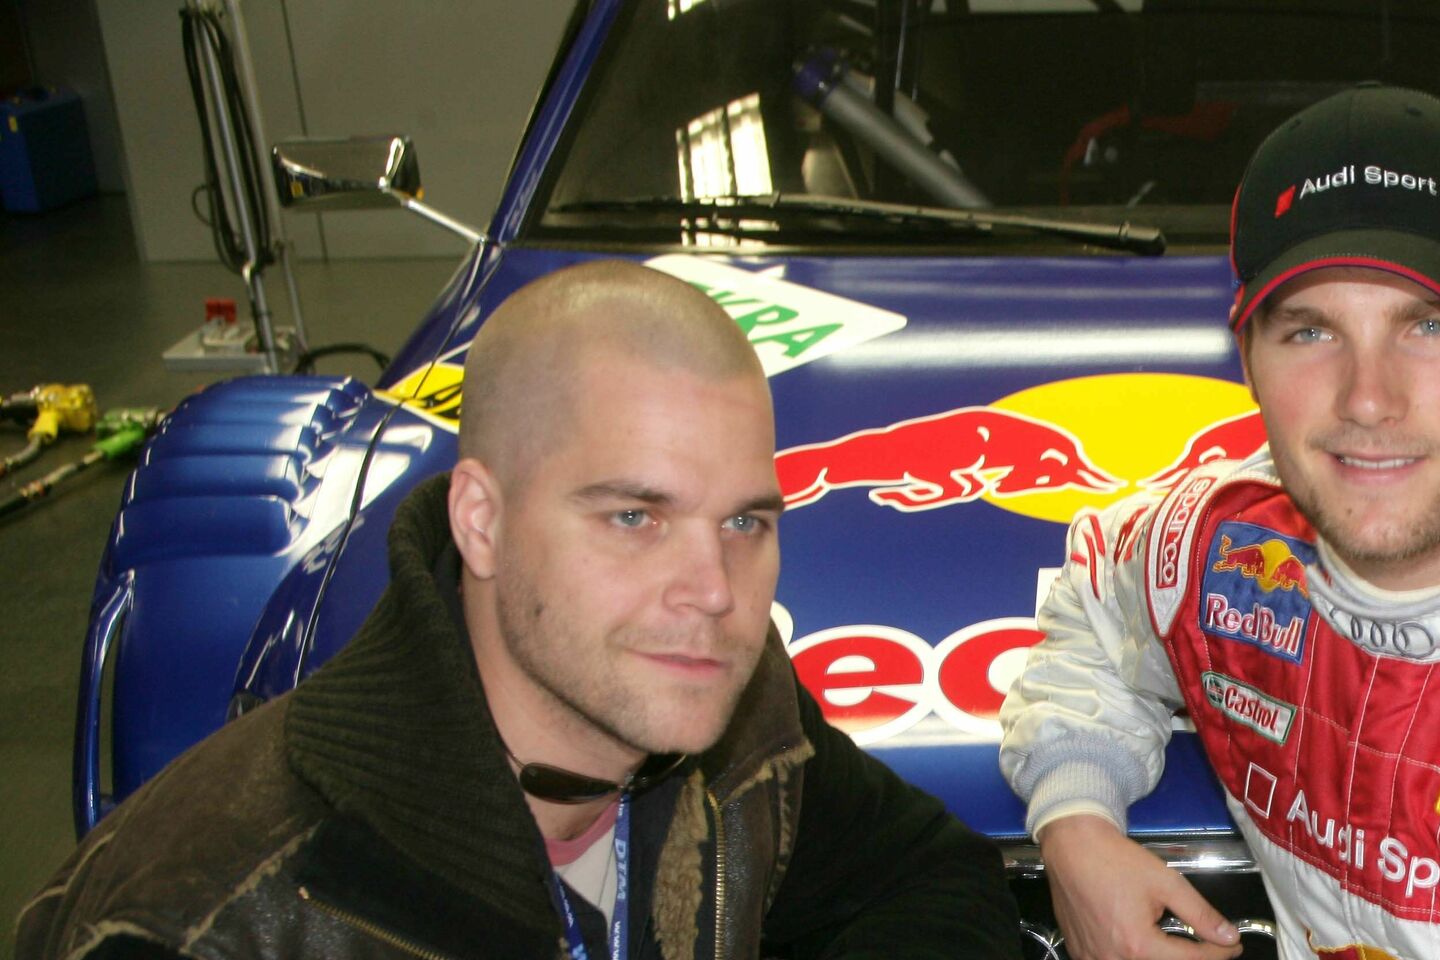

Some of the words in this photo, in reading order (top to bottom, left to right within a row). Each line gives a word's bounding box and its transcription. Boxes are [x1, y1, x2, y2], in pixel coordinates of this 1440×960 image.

[1299, 165, 1356, 200] Audi
[1363, 165, 1438, 197] Sport
[1160, 477, 1212, 584] sparco
[1223, 685, 1279, 734] Castrol
[1286, 789, 1366, 870] Audi
